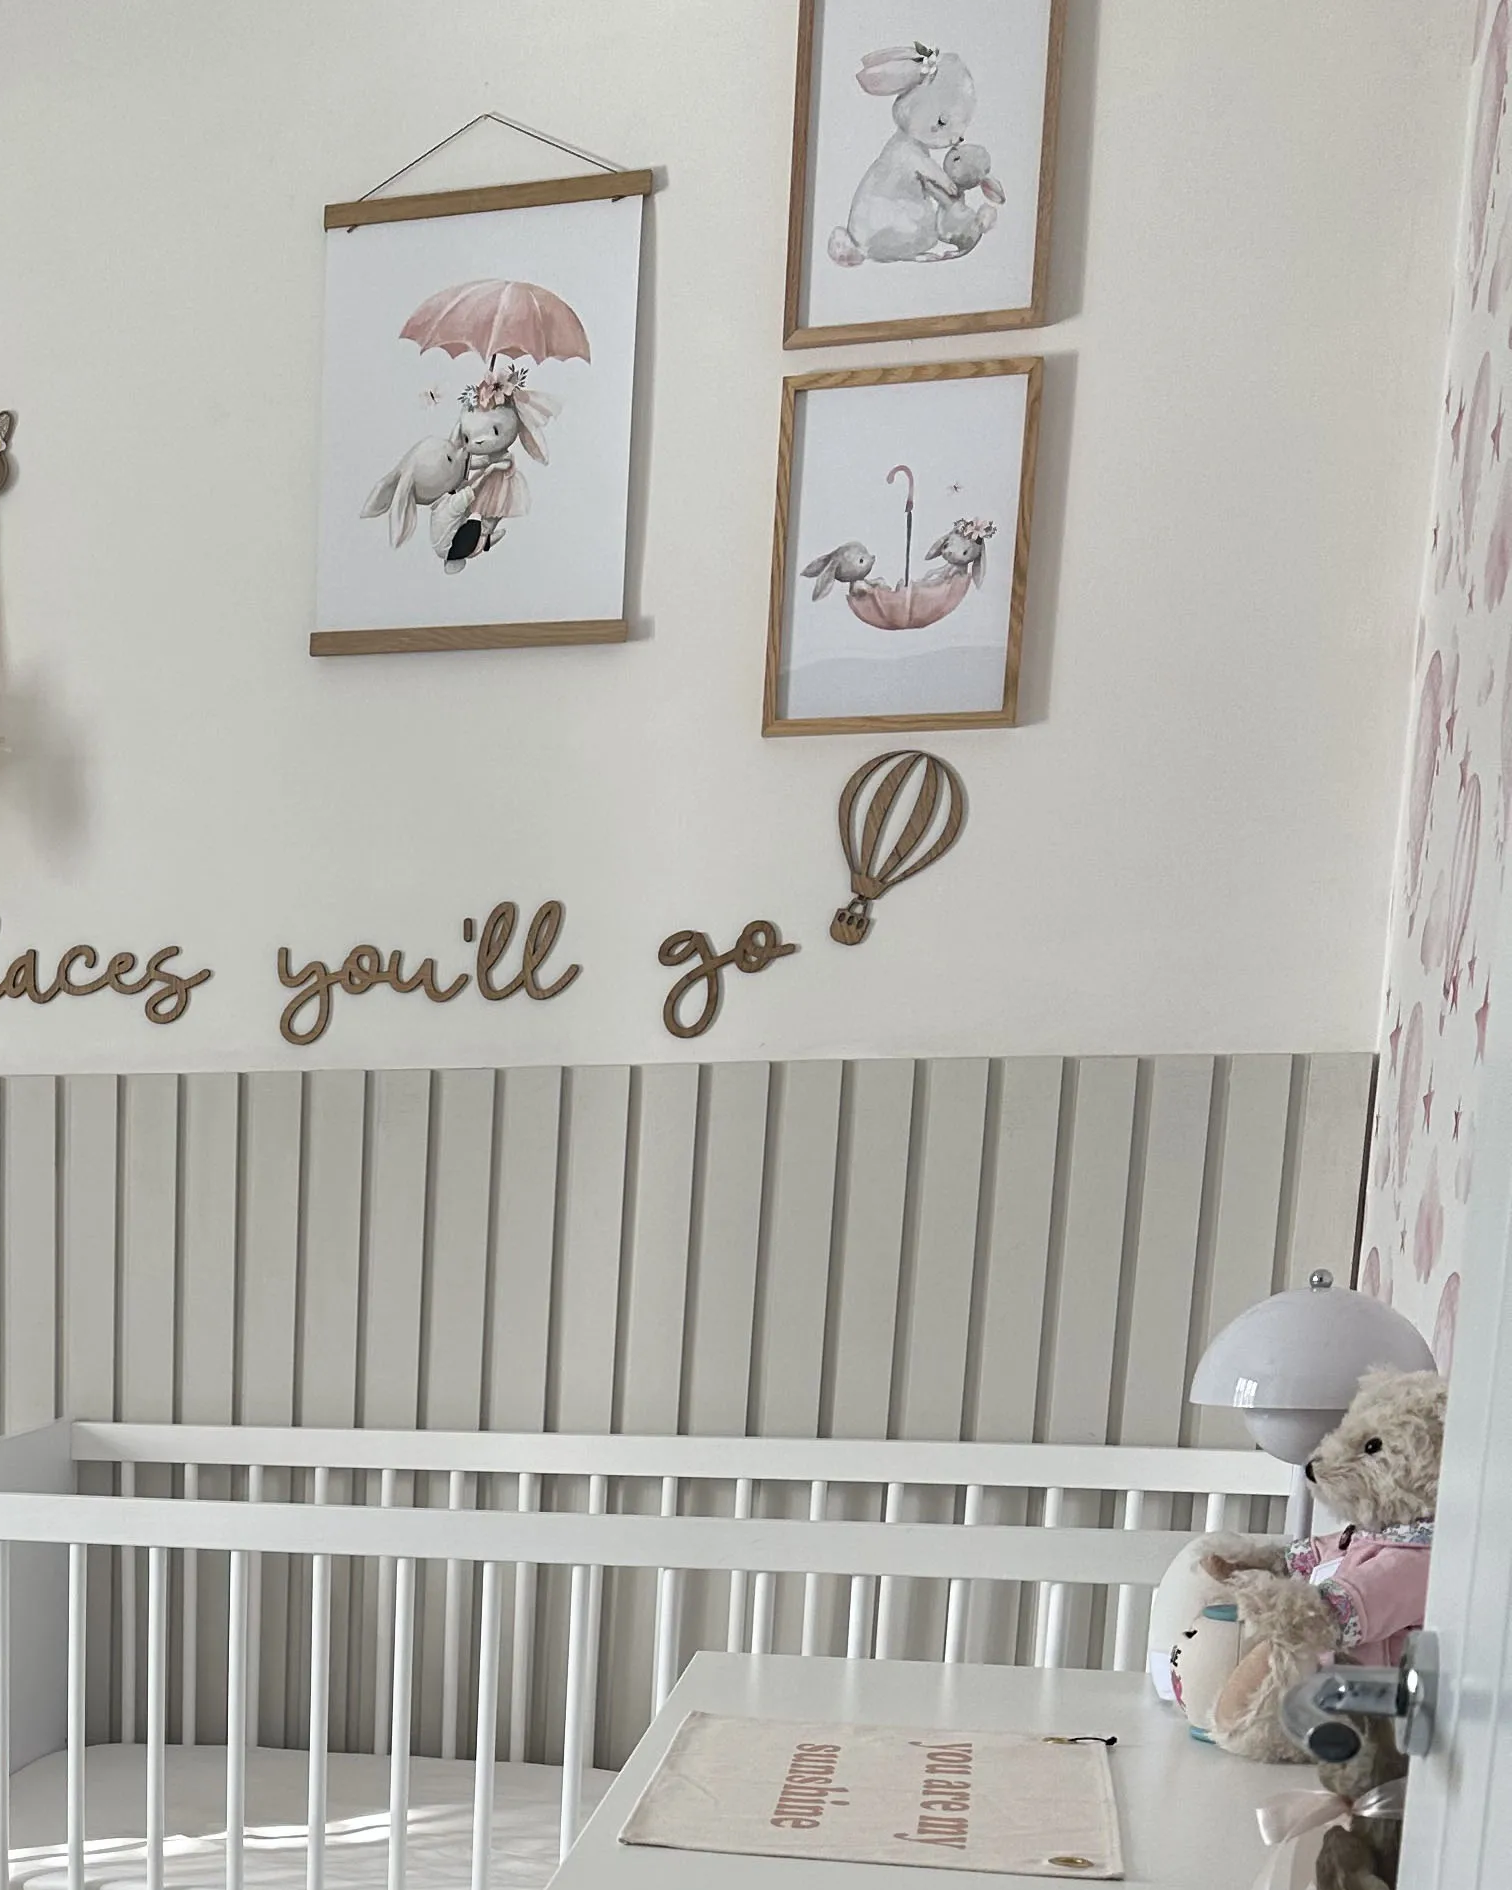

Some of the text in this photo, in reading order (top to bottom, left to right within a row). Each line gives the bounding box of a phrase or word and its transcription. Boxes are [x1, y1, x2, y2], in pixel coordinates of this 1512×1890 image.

[277, 900, 580, 1045] you'll
[658, 920, 797, 1039] go
[770, 1743, 850, 1829] sunshine
[893, 1742, 973, 1850] you are my
